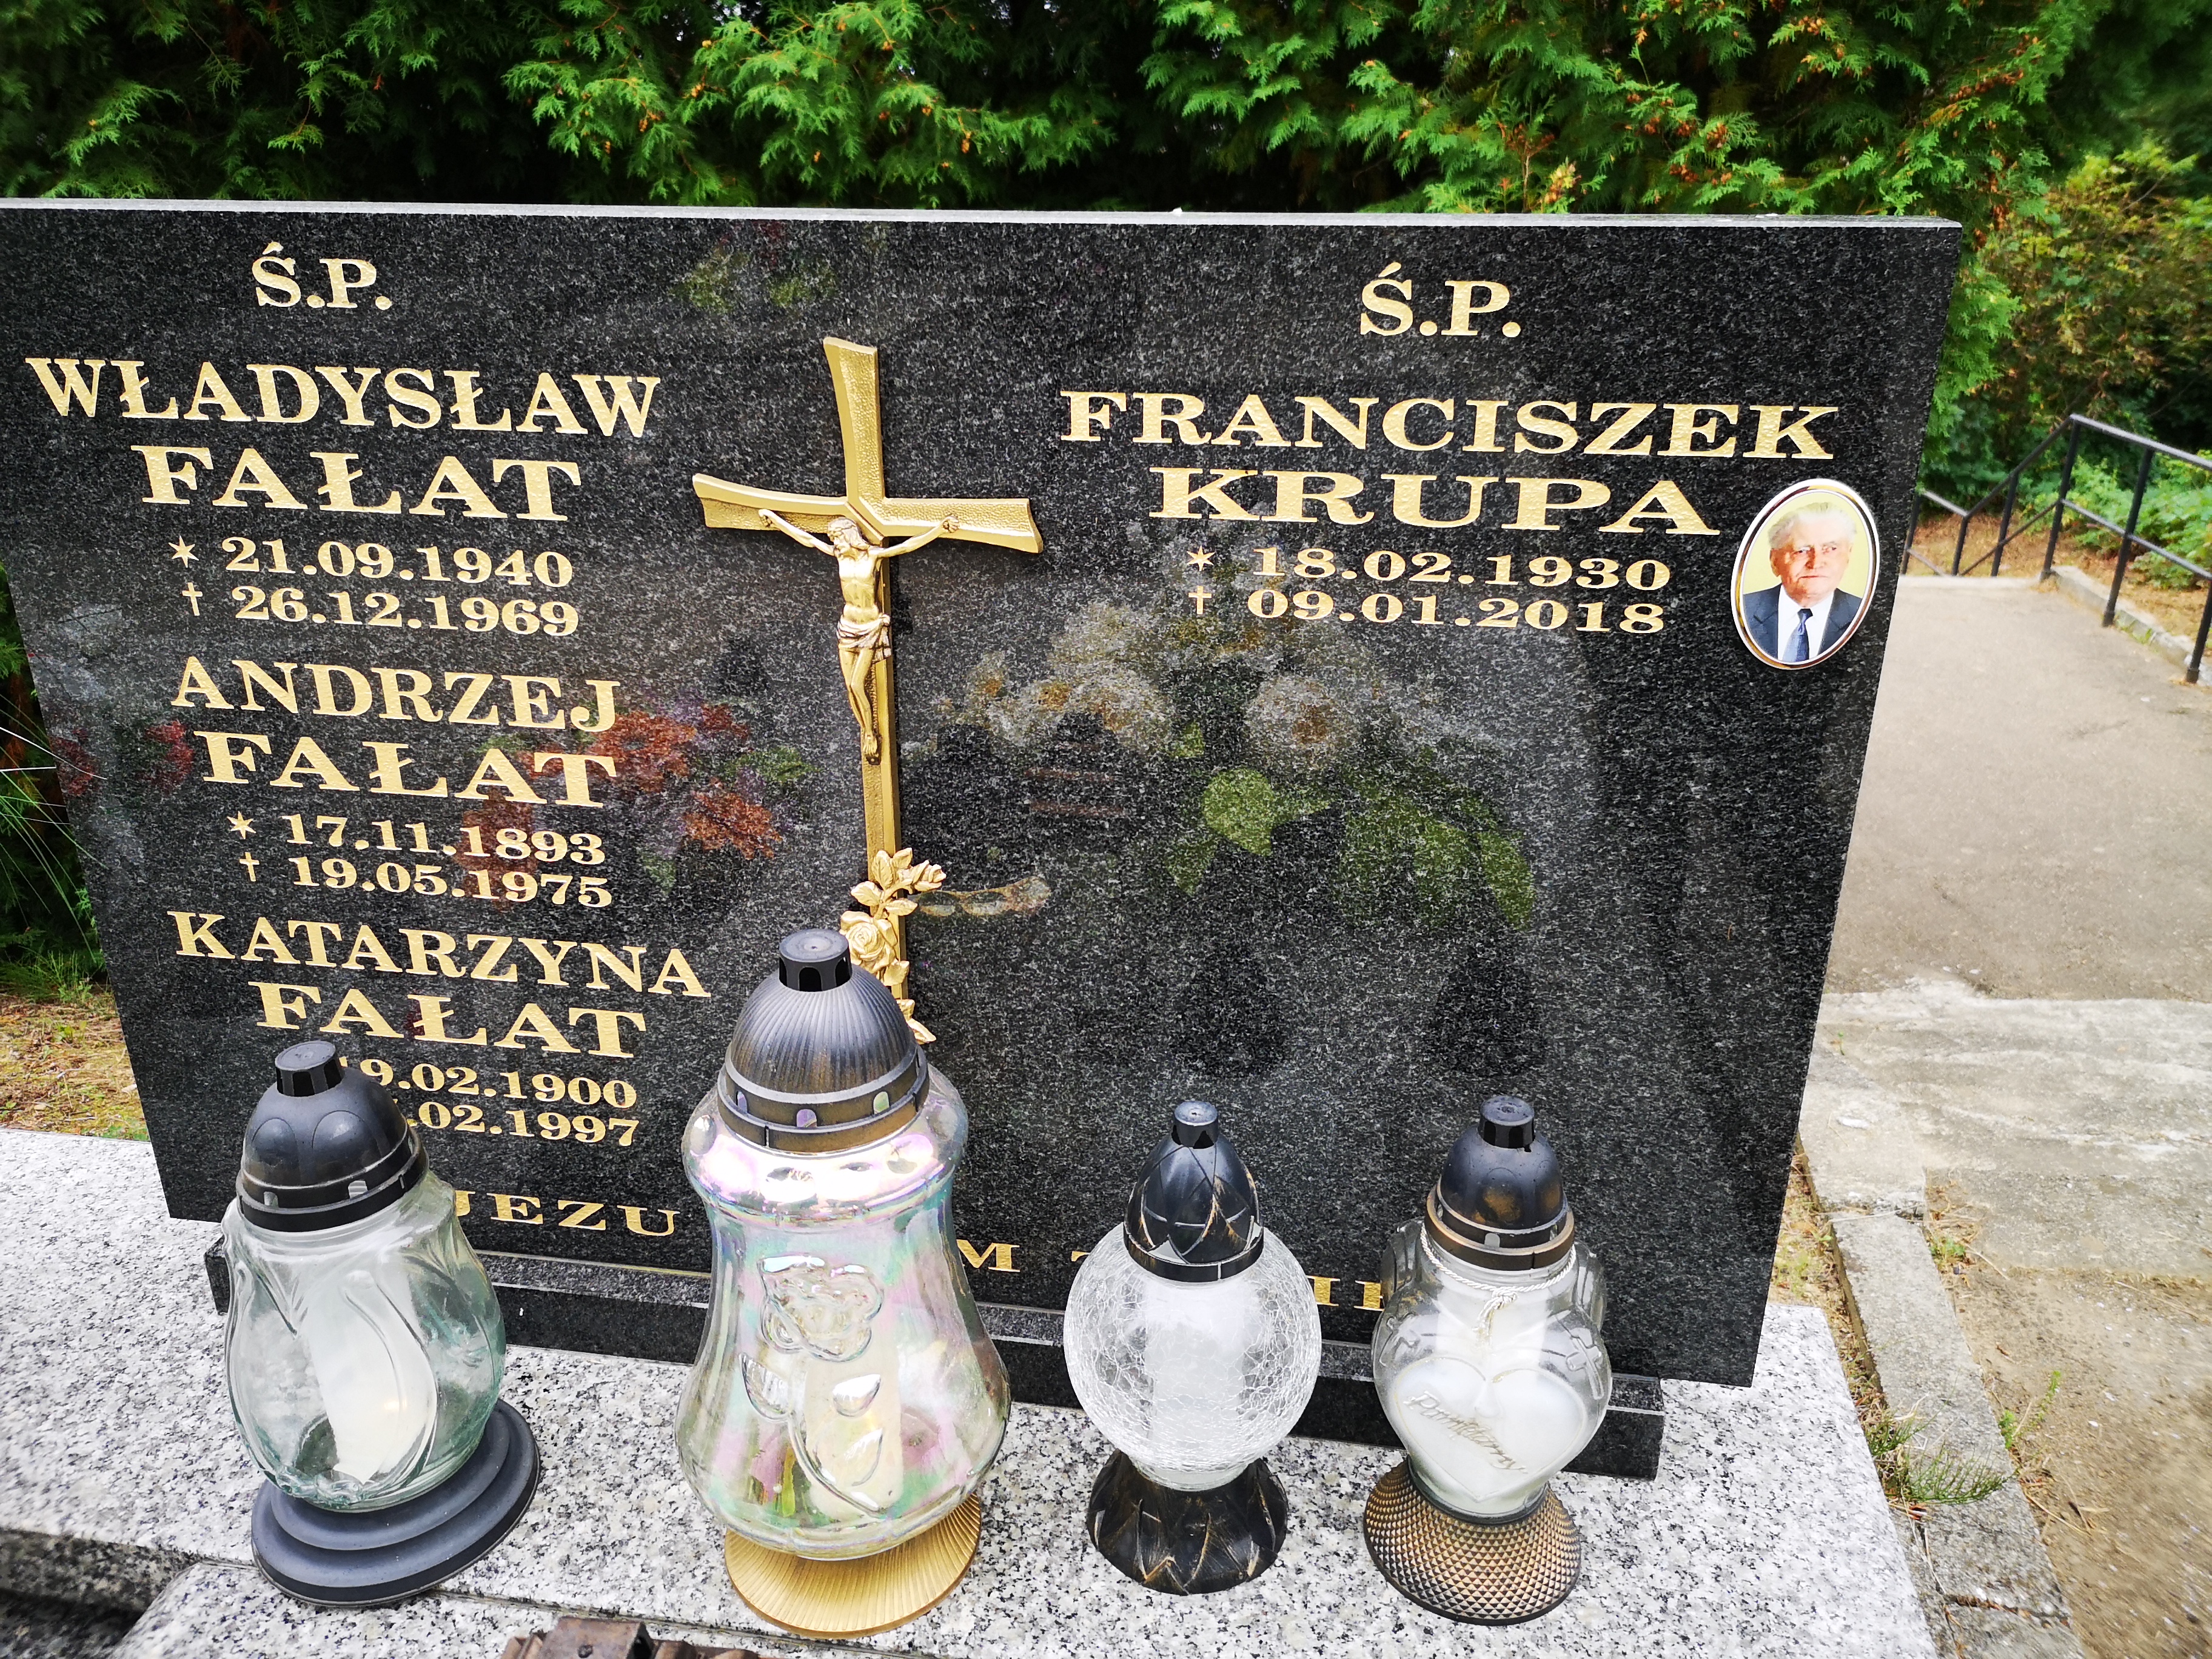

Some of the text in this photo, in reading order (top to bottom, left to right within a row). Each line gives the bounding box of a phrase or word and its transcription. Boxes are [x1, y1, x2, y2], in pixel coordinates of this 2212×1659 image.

[252, 241, 393, 310] Ś.P.
[1359, 261, 1521, 337] Ś.P.
[25, 357, 661, 438] WŁADYSŁAW
[1060, 390, 1839, 460] FRANCISZEK
[130, 444, 582, 521] FAŁAT
[1148, 466, 1721, 535] KRUPA
[221, 535, 573, 588] 21.09.1940
[1252, 546, 1672, 591] 18.02.1930
[231, 585, 580, 636] 26.12.1969
[1247, 588, 1664, 634] 09.01.2018
[170, 655, 621, 732] ANDRZEJ
[193, 730, 617, 809] FAŁAT
[281, 813, 605, 865] 17.11.1893
[288, 856, 612, 908] 19.05.1975
[167, 910, 712, 998] KATARZYNA
[247, 981, 647, 1059] FAŁAT
[340, 1056, 638, 1109] 9.02.1900
[393, 1100, 640, 1147] .02.1997
